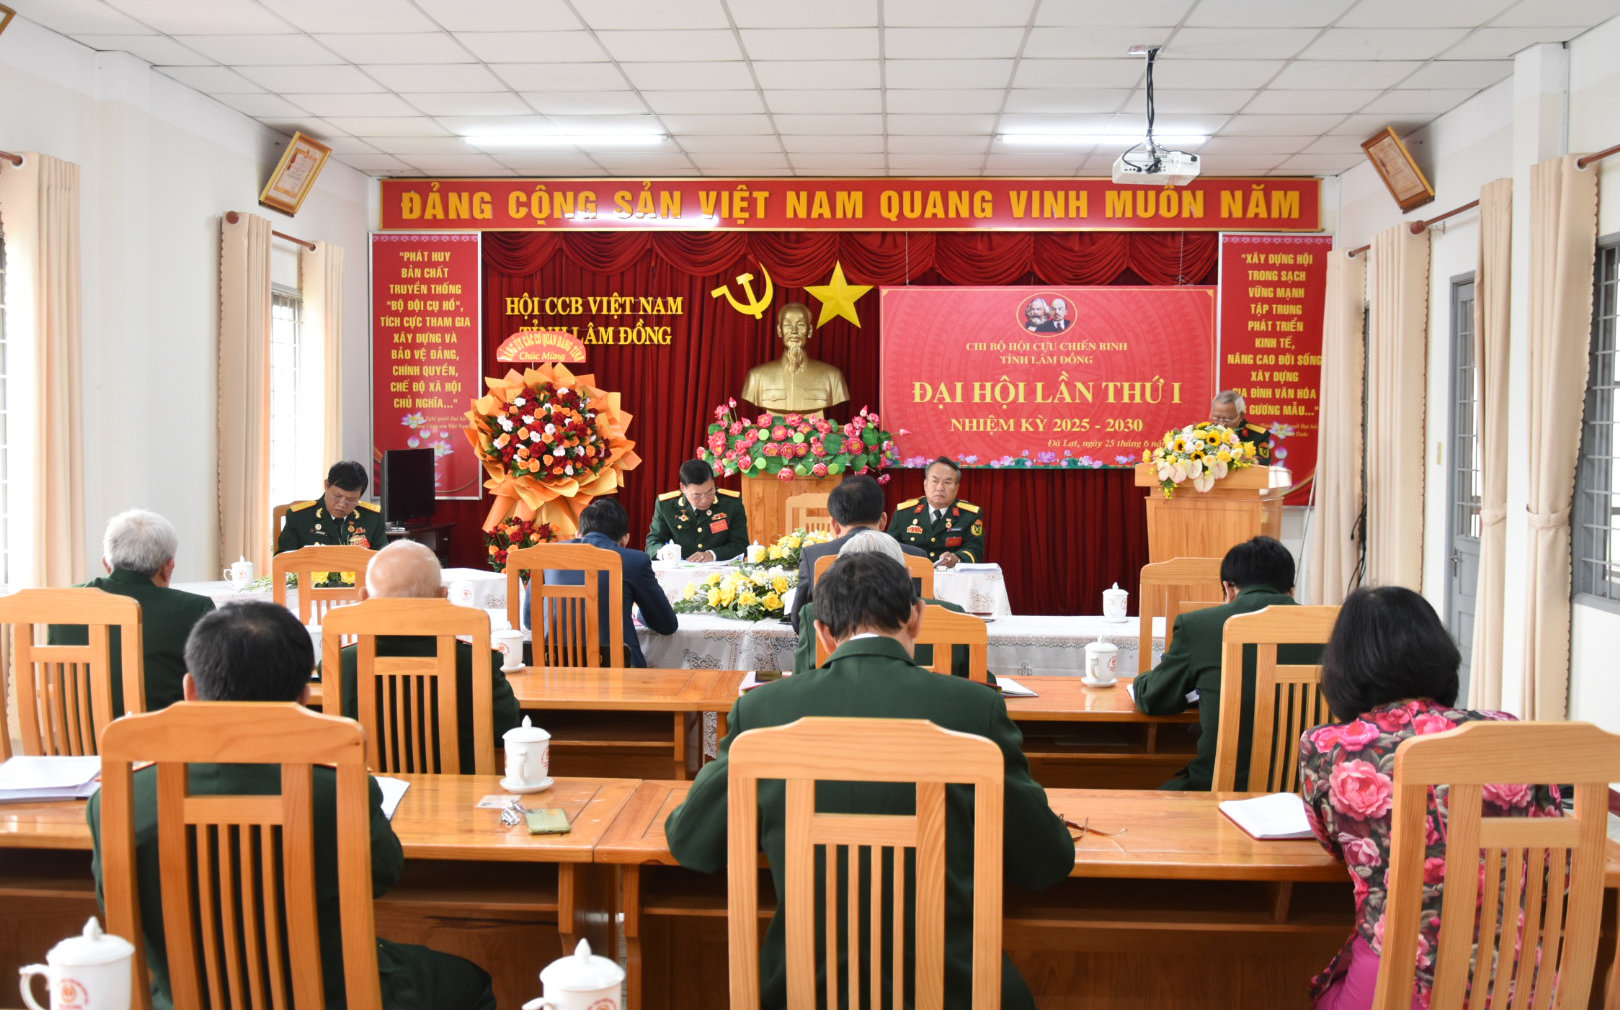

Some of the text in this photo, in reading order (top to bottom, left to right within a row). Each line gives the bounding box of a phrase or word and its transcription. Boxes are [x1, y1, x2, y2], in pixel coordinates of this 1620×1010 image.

[401, 181, 1300, 225] ĐẢNG CỘNG SẢN VIỆT NAM QUANG VINH MUÔN NĂM
[432, 251, 451, 262] HUY
[1269, 252, 1294, 267] DỰNG
[1297, 252, 1313, 267] HỘI
[401, 265, 449, 278] BẢN CHẤT
[1248, 270, 1306, 284] TRONG SẠCH
[389, 281, 462, 295] TRUYỀN THỐNG
[1248, 285, 1305, 301] VỮNG MẠNH
[407, 299, 424, 313] ĐỘI
[426, 301, 440, 313] CỤ
[506, 292, 684, 319] HỘI CCB VIỆT NAM
[1250, 302, 1302, 317] TẬP TRUNG
[380, 315, 471, 329] TÍCH CỰC THAM GIA
[1248, 316, 1304, 332] PHÁT TRIỂN
[393, 331, 458, 346] XÂY DỰNG VÀ
[573, 322, 614, 345] LÂM
[619, 319, 671, 345] ĐỒNG
[966, 339, 1128, 353] CHI BỘ HỘI CỰU CHIẾN BINH
[1255, 335, 1295, 350] KINH TẾ,
[391, 347, 460, 361] BẢO VỆ ĐẢNG,
[1000, 352, 1094, 364] TỈNH LÂM ĐỒNG
[1228, 352, 1254, 364] NÂNG
[1256, 354, 1275, 365] CAO
[1278, 352, 1295, 365] ĐỜI
[393, 362, 459, 377] CHÍNH QUYỀN,
[1251, 369, 1299, 384] XÂY DỰNG
[390, 379, 462, 394] CHẾ ĐỘ XÃ HỘI
[912, 371, 1182, 409] ĐẠI HỘI LẦN THỨ I
[1251, 387, 1272, 399] ĐÌNH
[1274, 387, 1295, 399] VĂN
[1297, 387, 1317, 399] HÓA
[394, 395, 412, 408] CHỦ
[1249, 403, 1280, 415] GƯƠNG
[950, 414, 1014, 436] NHIỆM
[1020, 414, 1047, 432] KỲ
[1053, 418, 1091, 432] 2025
[1105, 418, 1143, 432] 2030
[1048, 439, 1061, 448] Đà
[1062, 439, 1080, 449] Lạt,
[1082, 440, 1103, 450] ngày
[1105, 439, 1115, 447] 25
[1117, 439, 1142, 449] tháng
[1144, 439, 1149, 447] 6
